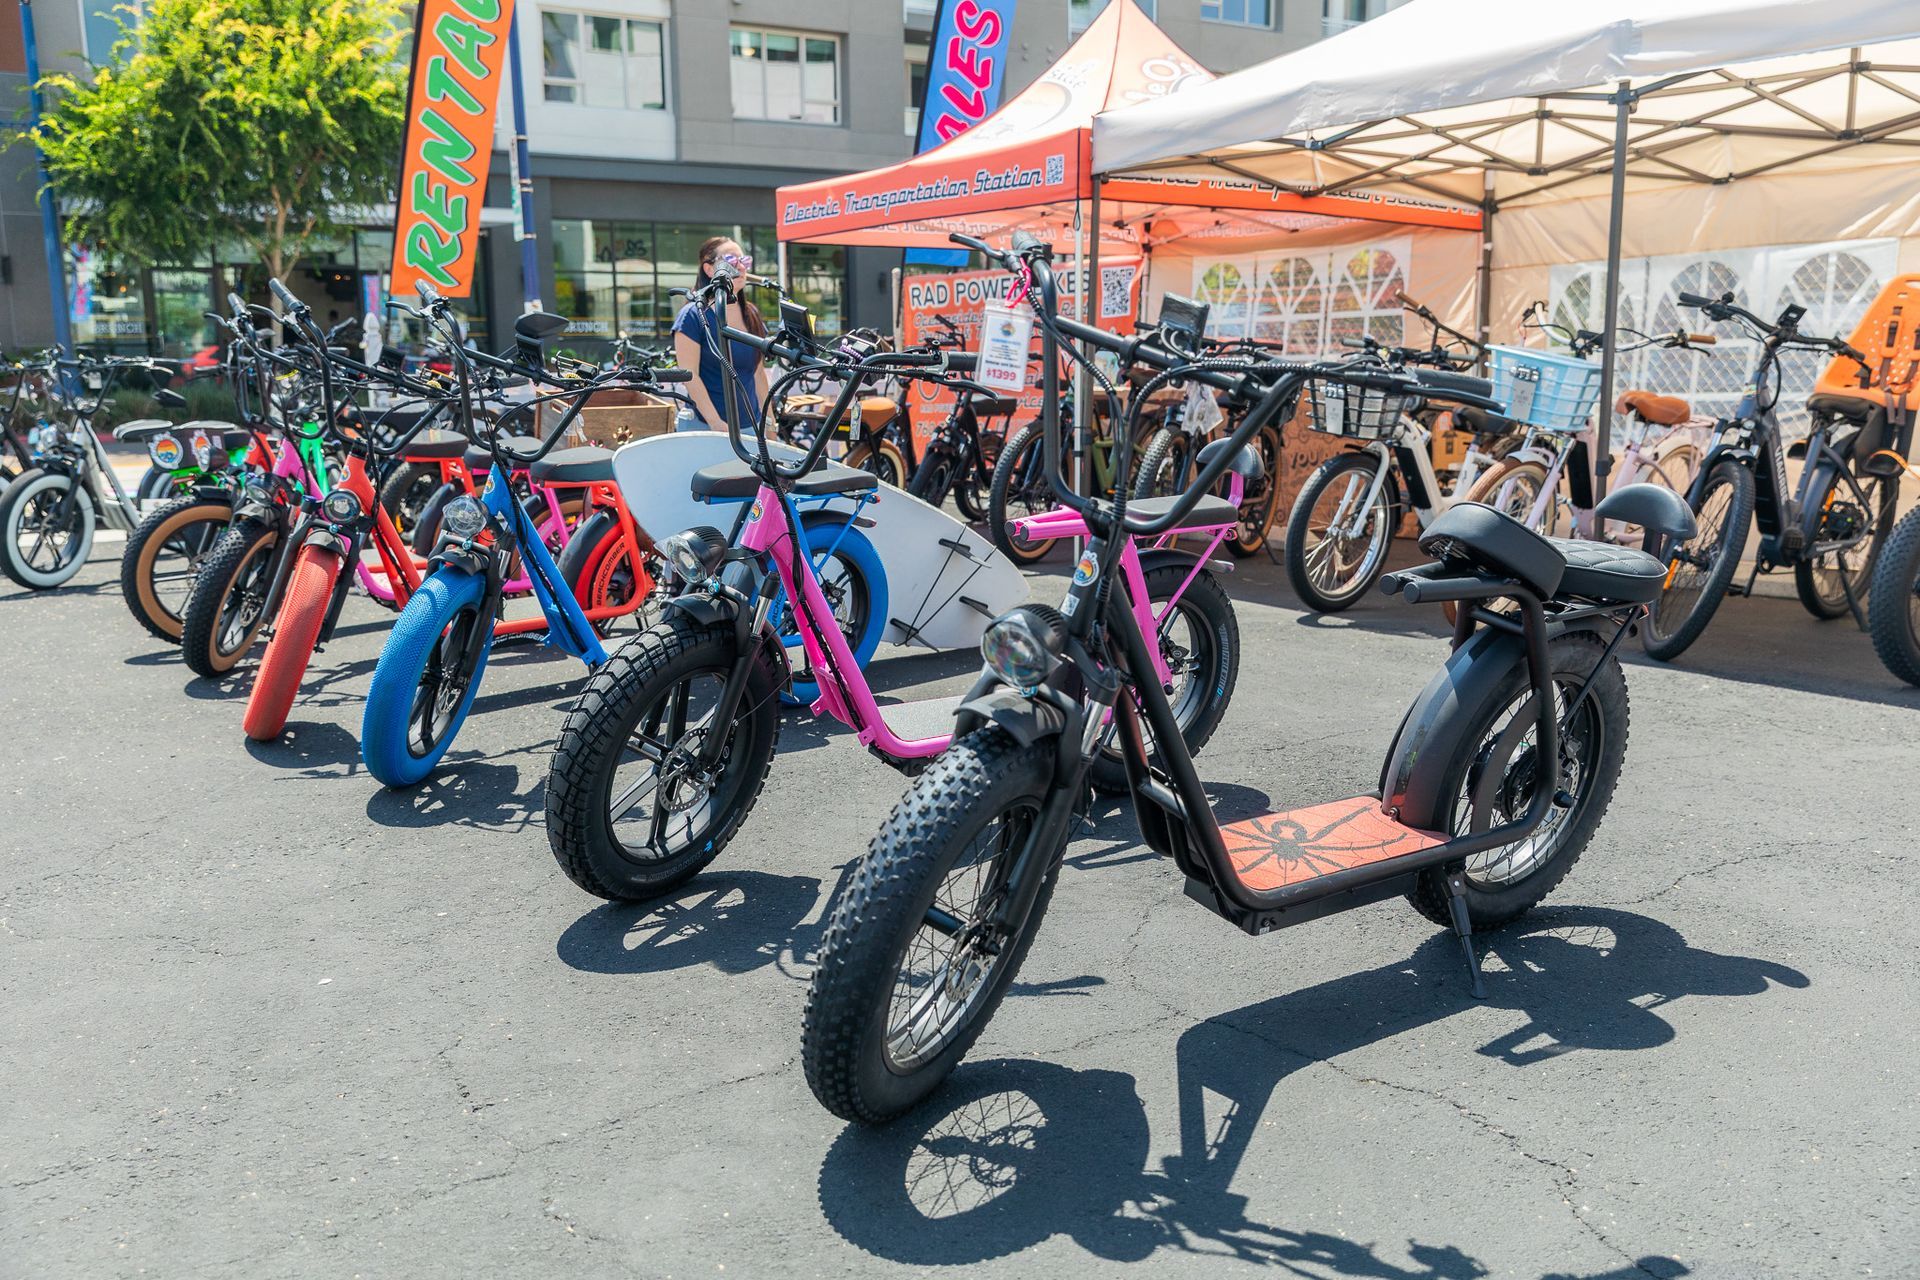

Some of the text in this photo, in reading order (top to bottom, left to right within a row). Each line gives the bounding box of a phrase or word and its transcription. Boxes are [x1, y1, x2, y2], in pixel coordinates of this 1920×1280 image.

[784, 164, 1042, 225] Electric Transportation Station
[910, 283, 949, 307] RAD
[985, 367, 1017, 381] $1399
[596, 542, 625, 606] BEACHCOMBER
